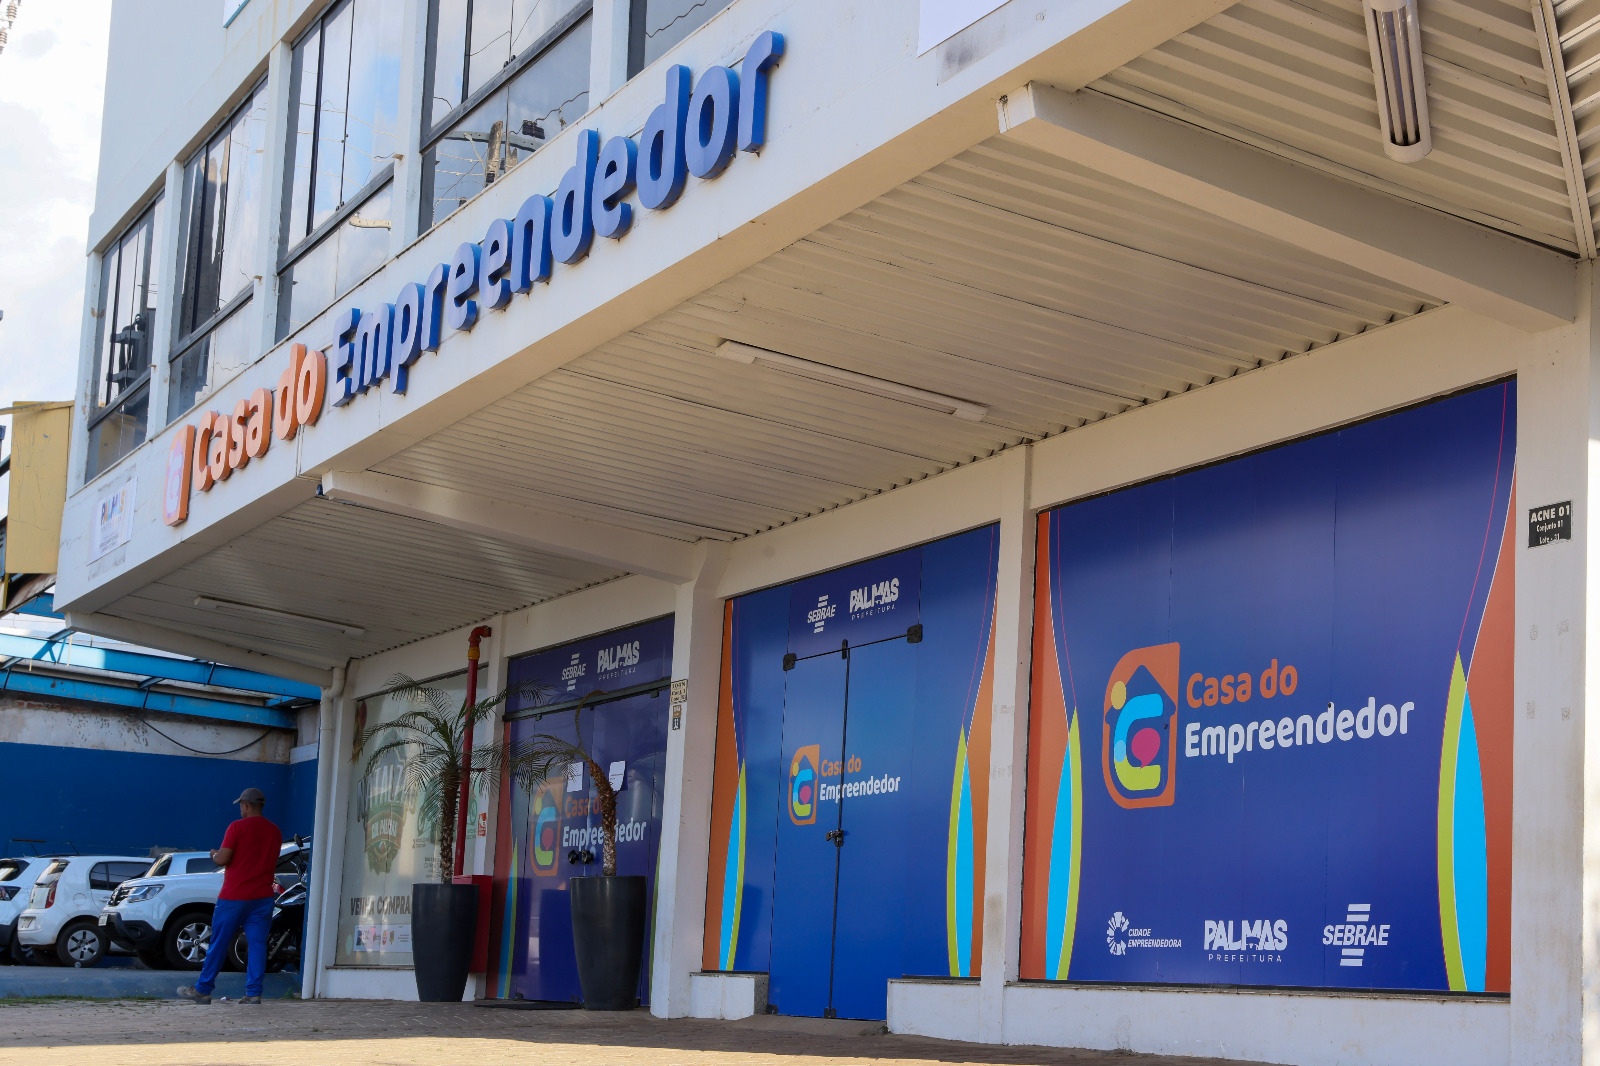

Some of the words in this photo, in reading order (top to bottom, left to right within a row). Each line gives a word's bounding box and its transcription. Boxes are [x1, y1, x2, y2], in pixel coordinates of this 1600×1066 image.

[193, 387, 273, 492] Casa
[274, 343, 326, 440] do
[333, 30, 784, 407] Empreendedor
[1530, 508, 1556, 523] ACNE
[1558, 505, 1570, 517] 01
[849, 577, 899, 613] PALMAS
[807, 604, 837, 624] SEBRAE
[851, 604, 896, 621] PREFEITURA
[596, 640, 640, 674] PALMAS
[561, 662, 587, 681] SEBRAE
[1186, 672, 1252, 708] Casa
[1260, 658, 1298, 699] do
[1185, 696, 1415, 764] Empreendedor
[821, 759, 845, 777] Casa
[847, 754, 862, 773] do
[820, 773, 901, 804] Empreendedor
[565, 796, 590, 818] Casa
[562, 817, 647, 851] Empreeedor
[1127, 939, 1182, 948] EMPREENDEDORA
[1128, 928, 1152, 937] CIDADE
[1203, 919, 1288, 951] PALMAS
[1322, 924, 1391, 946] SEBRAE
[1208, 953, 1283, 963] PREFEITURA
